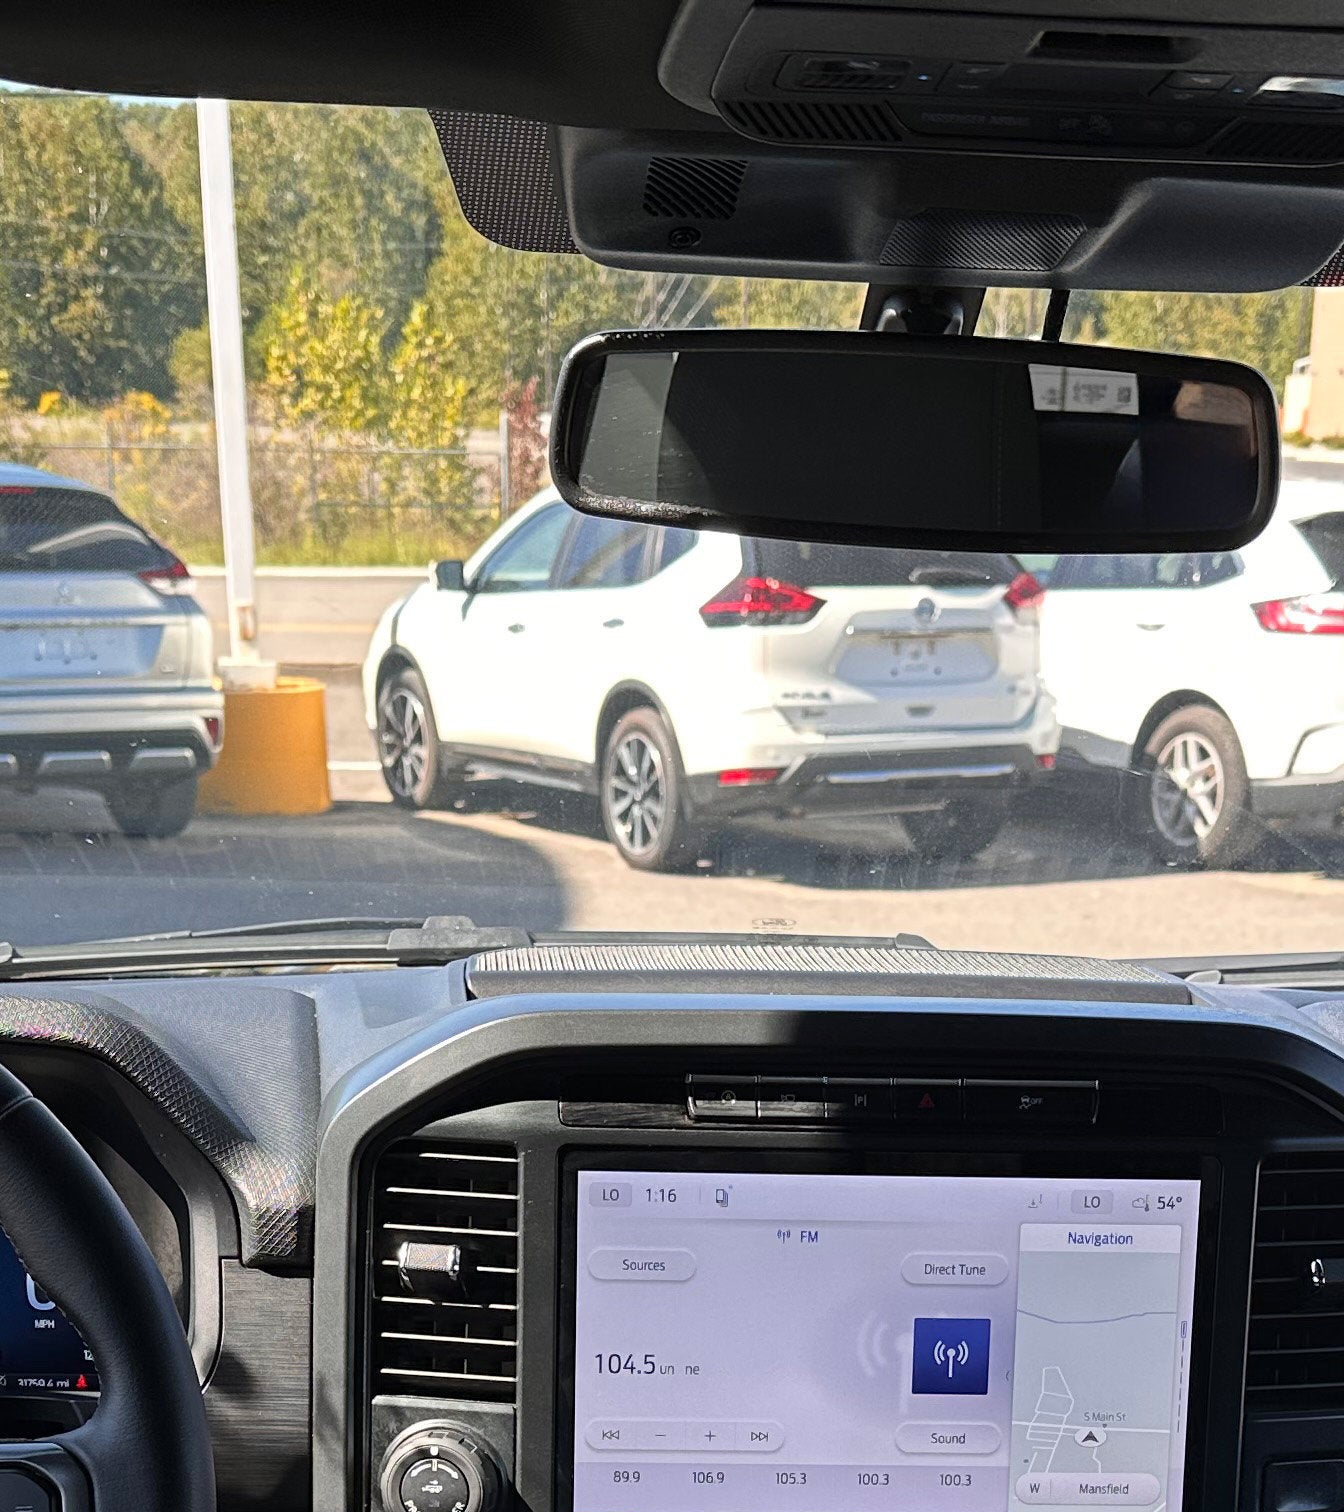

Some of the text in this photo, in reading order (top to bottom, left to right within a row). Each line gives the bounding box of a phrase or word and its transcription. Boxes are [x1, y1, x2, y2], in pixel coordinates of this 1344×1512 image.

[602, 1189, 620, 1201] LO
[645, 1189, 677, 1203] 1:16
[1083, 1196, 1101, 1209] LO
[1157, 1196, 1183, 1211] 54°
[800, 1230, 819, 1243] FM
[1068, 1231, 1134, 1247] Navigation
[622, 1258, 666, 1272] Sources
[924, 1263, 986, 1277] Direct Tune
[34, 1319, 55, 1329] MPH
[594, 1353, 656, 1376] 104.5
[1083, 1412, 1127, 1422] S Main St
[930, 1433, 966, 1445] Sound
[613, 1470, 972, 1486] 89.9 106.9 105.3 100.3 100.3
[1029, 1483, 1041, 1494] W
[1079, 1483, 1129, 1495] Mansfield
